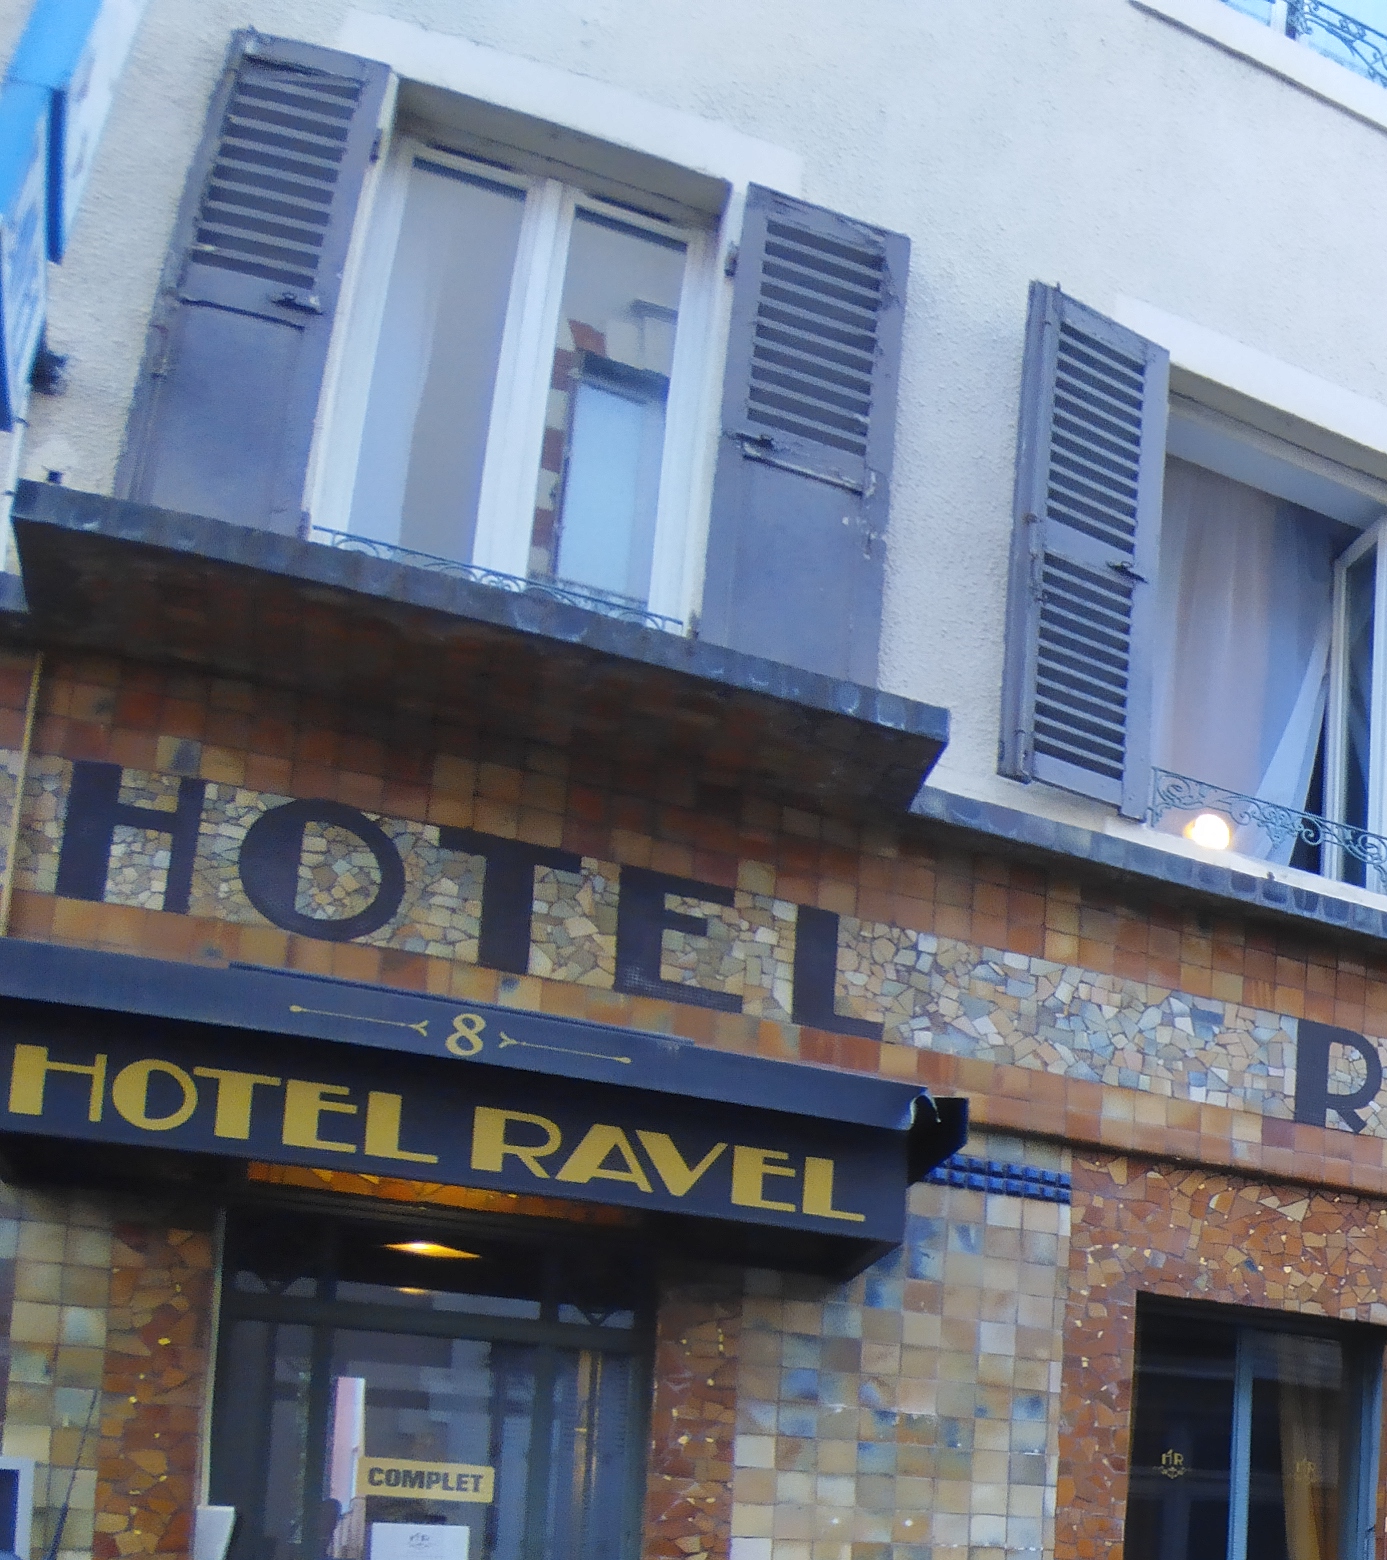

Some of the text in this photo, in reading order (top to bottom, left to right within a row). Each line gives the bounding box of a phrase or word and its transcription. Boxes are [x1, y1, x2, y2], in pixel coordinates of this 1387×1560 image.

[56, 762, 885, 1040] HOTEL
[444, 1013, 487, 1057] 8
[8, 1044, 866, 1223] HOTEL RAVEL
[368, 1467, 484, 1493] COMPLET
